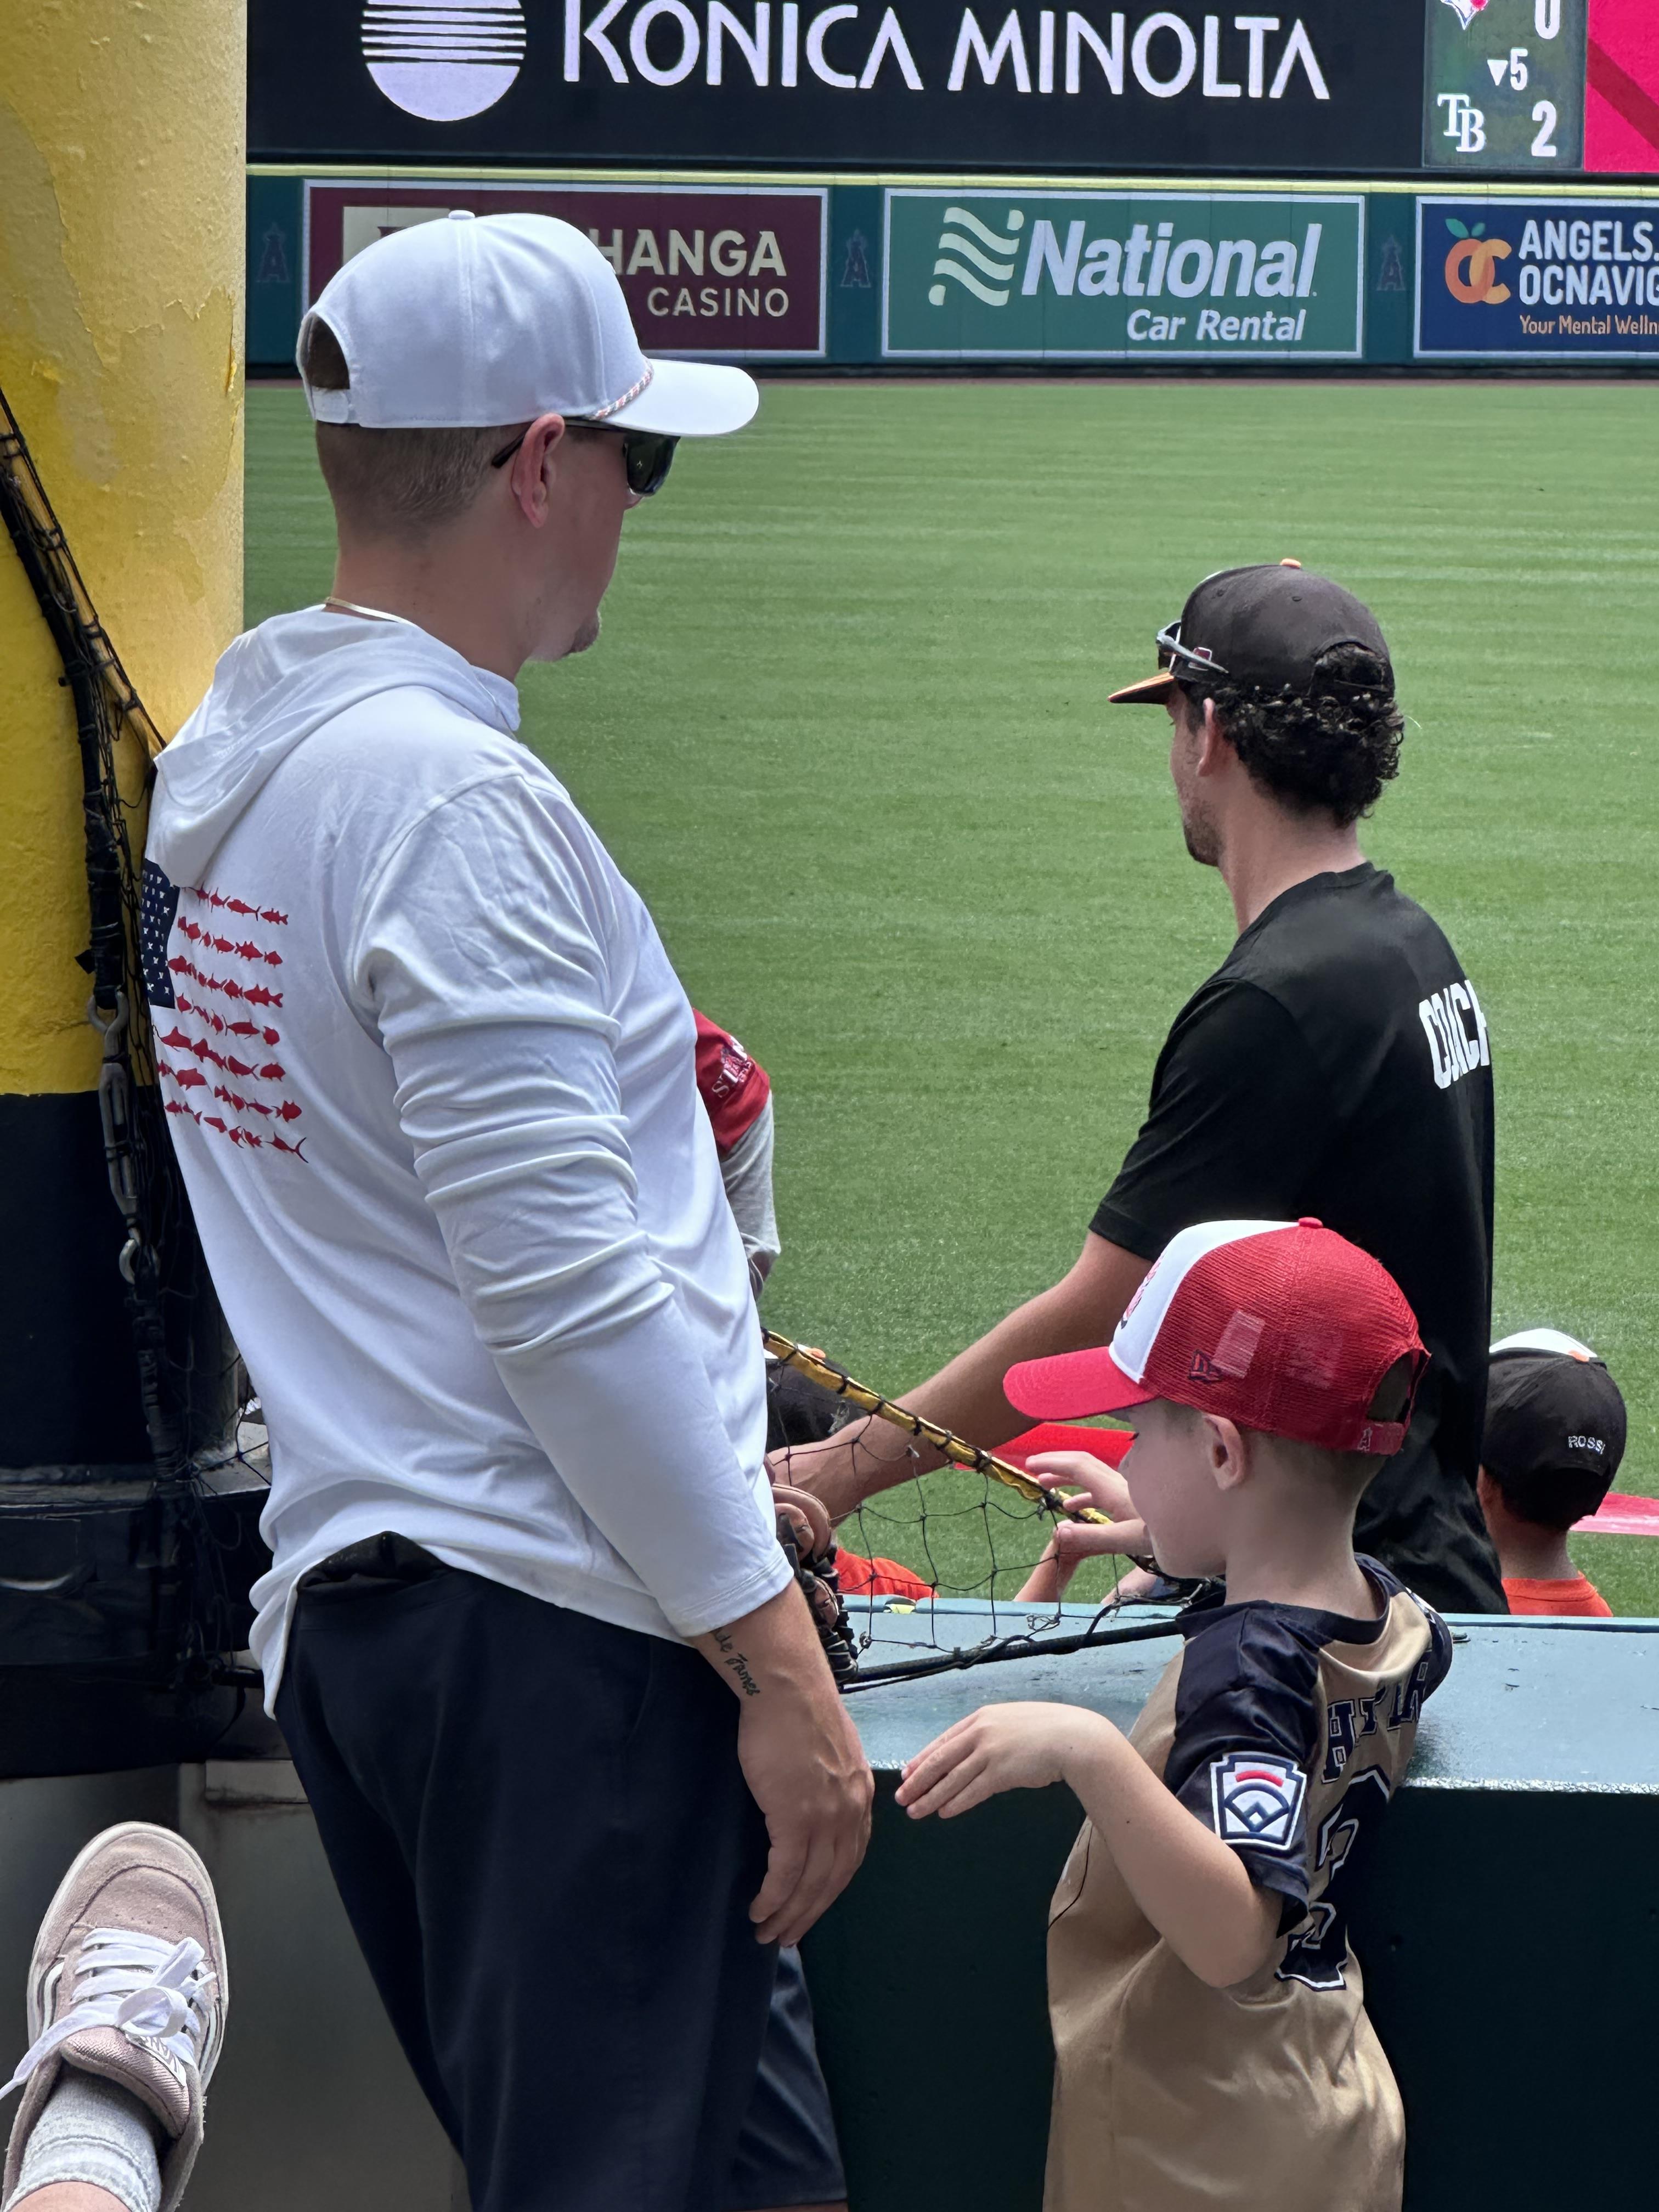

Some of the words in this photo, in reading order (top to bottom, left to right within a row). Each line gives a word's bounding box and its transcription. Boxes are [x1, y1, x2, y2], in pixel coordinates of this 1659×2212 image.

[563, 0, 924, 90] KONICA
[947, 7, 1330, 100] MINOLTA
[1510, 47, 1528, 91] 5
[1437, 94, 1487, 152] TB
[1531, 100, 1557, 157] 2
[1021, 219, 1322, 298] National
[647, 286, 789, 318] CASINO
[1126, 309, 1186, 341] Car
[1195, 309, 1307, 341] Rental
[1520, 315, 1556, 334] Your
[1559, 315, 1611, 335] Mental
